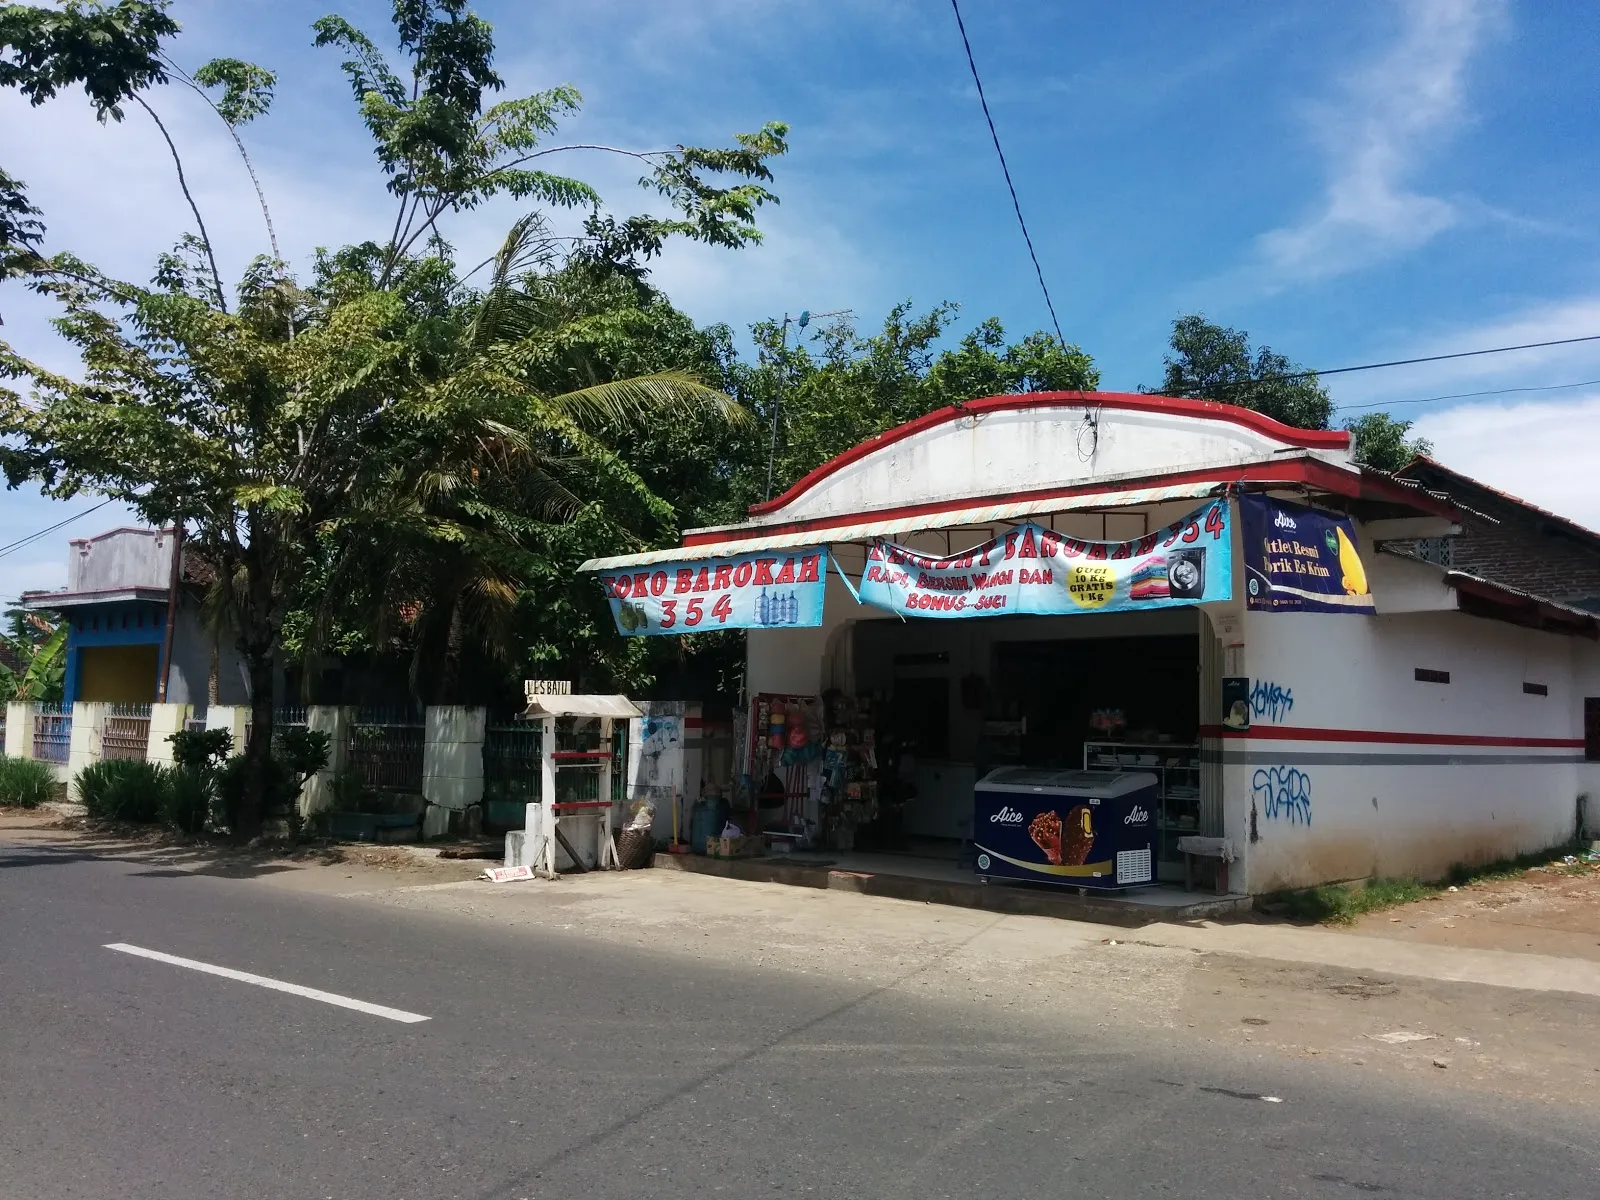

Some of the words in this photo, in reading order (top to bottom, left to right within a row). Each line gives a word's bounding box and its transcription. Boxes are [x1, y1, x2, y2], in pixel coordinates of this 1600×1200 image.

[1163, 506, 1225, 548] 354
[1292, 540, 1320, 559] Resmi
[602, 570, 668, 599] TOKO
[673, 553, 822, 594] BAROKAH
[1018, 568, 1053, 584] DAN
[1076, 566, 1108, 574] CUCI
[1295, 559, 1307, 574] Es
[1306, 561, 1331, 577] Krim
[1069, 581, 1114, 593] GRATIS
[1075, 575, 1086, 583] 10
[990, 806, 1024, 823] Aice
[1124, 804, 1149, 825] Aice
